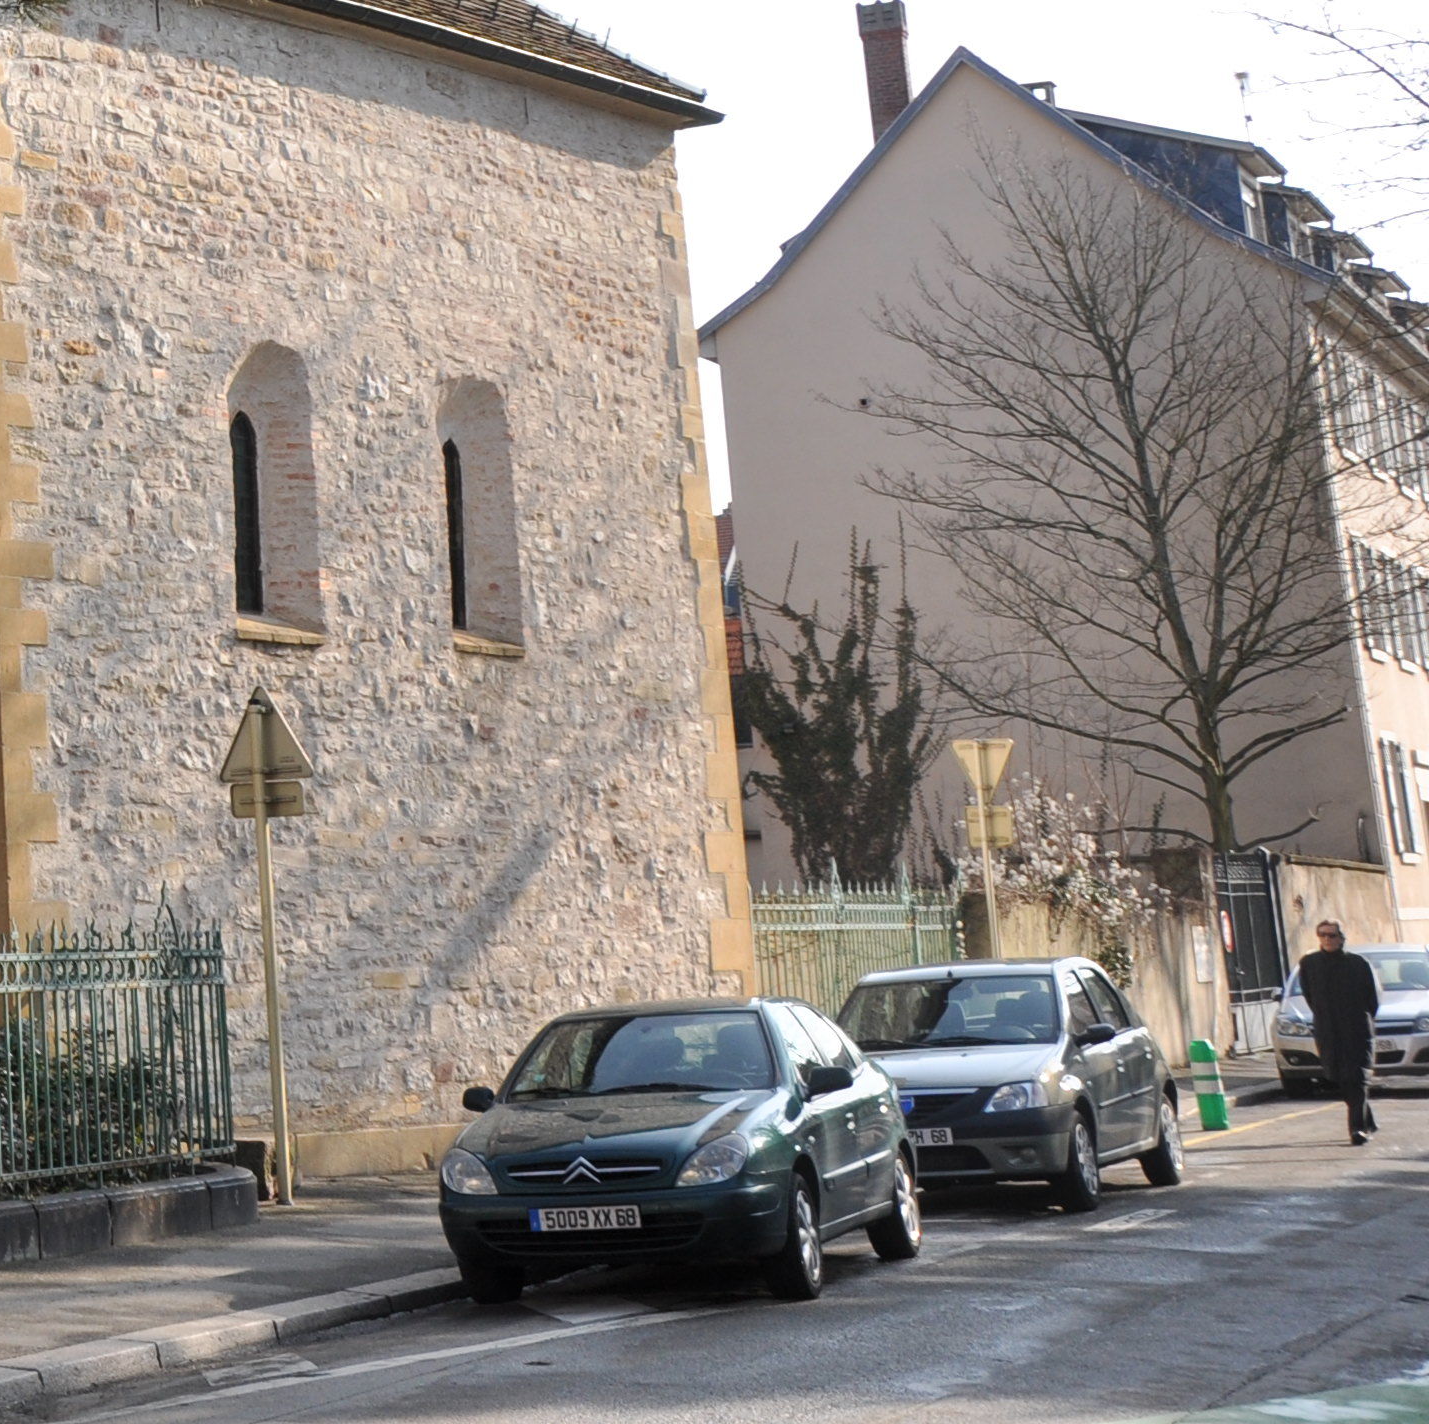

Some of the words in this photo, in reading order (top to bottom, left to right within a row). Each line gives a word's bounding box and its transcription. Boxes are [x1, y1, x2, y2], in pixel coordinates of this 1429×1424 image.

[930, 1128, 948, 1144] 68
[544, 1209, 590, 1229] 5009
[591, 1208, 613, 1228] XX
[614, 1207, 638, 1227] 68
